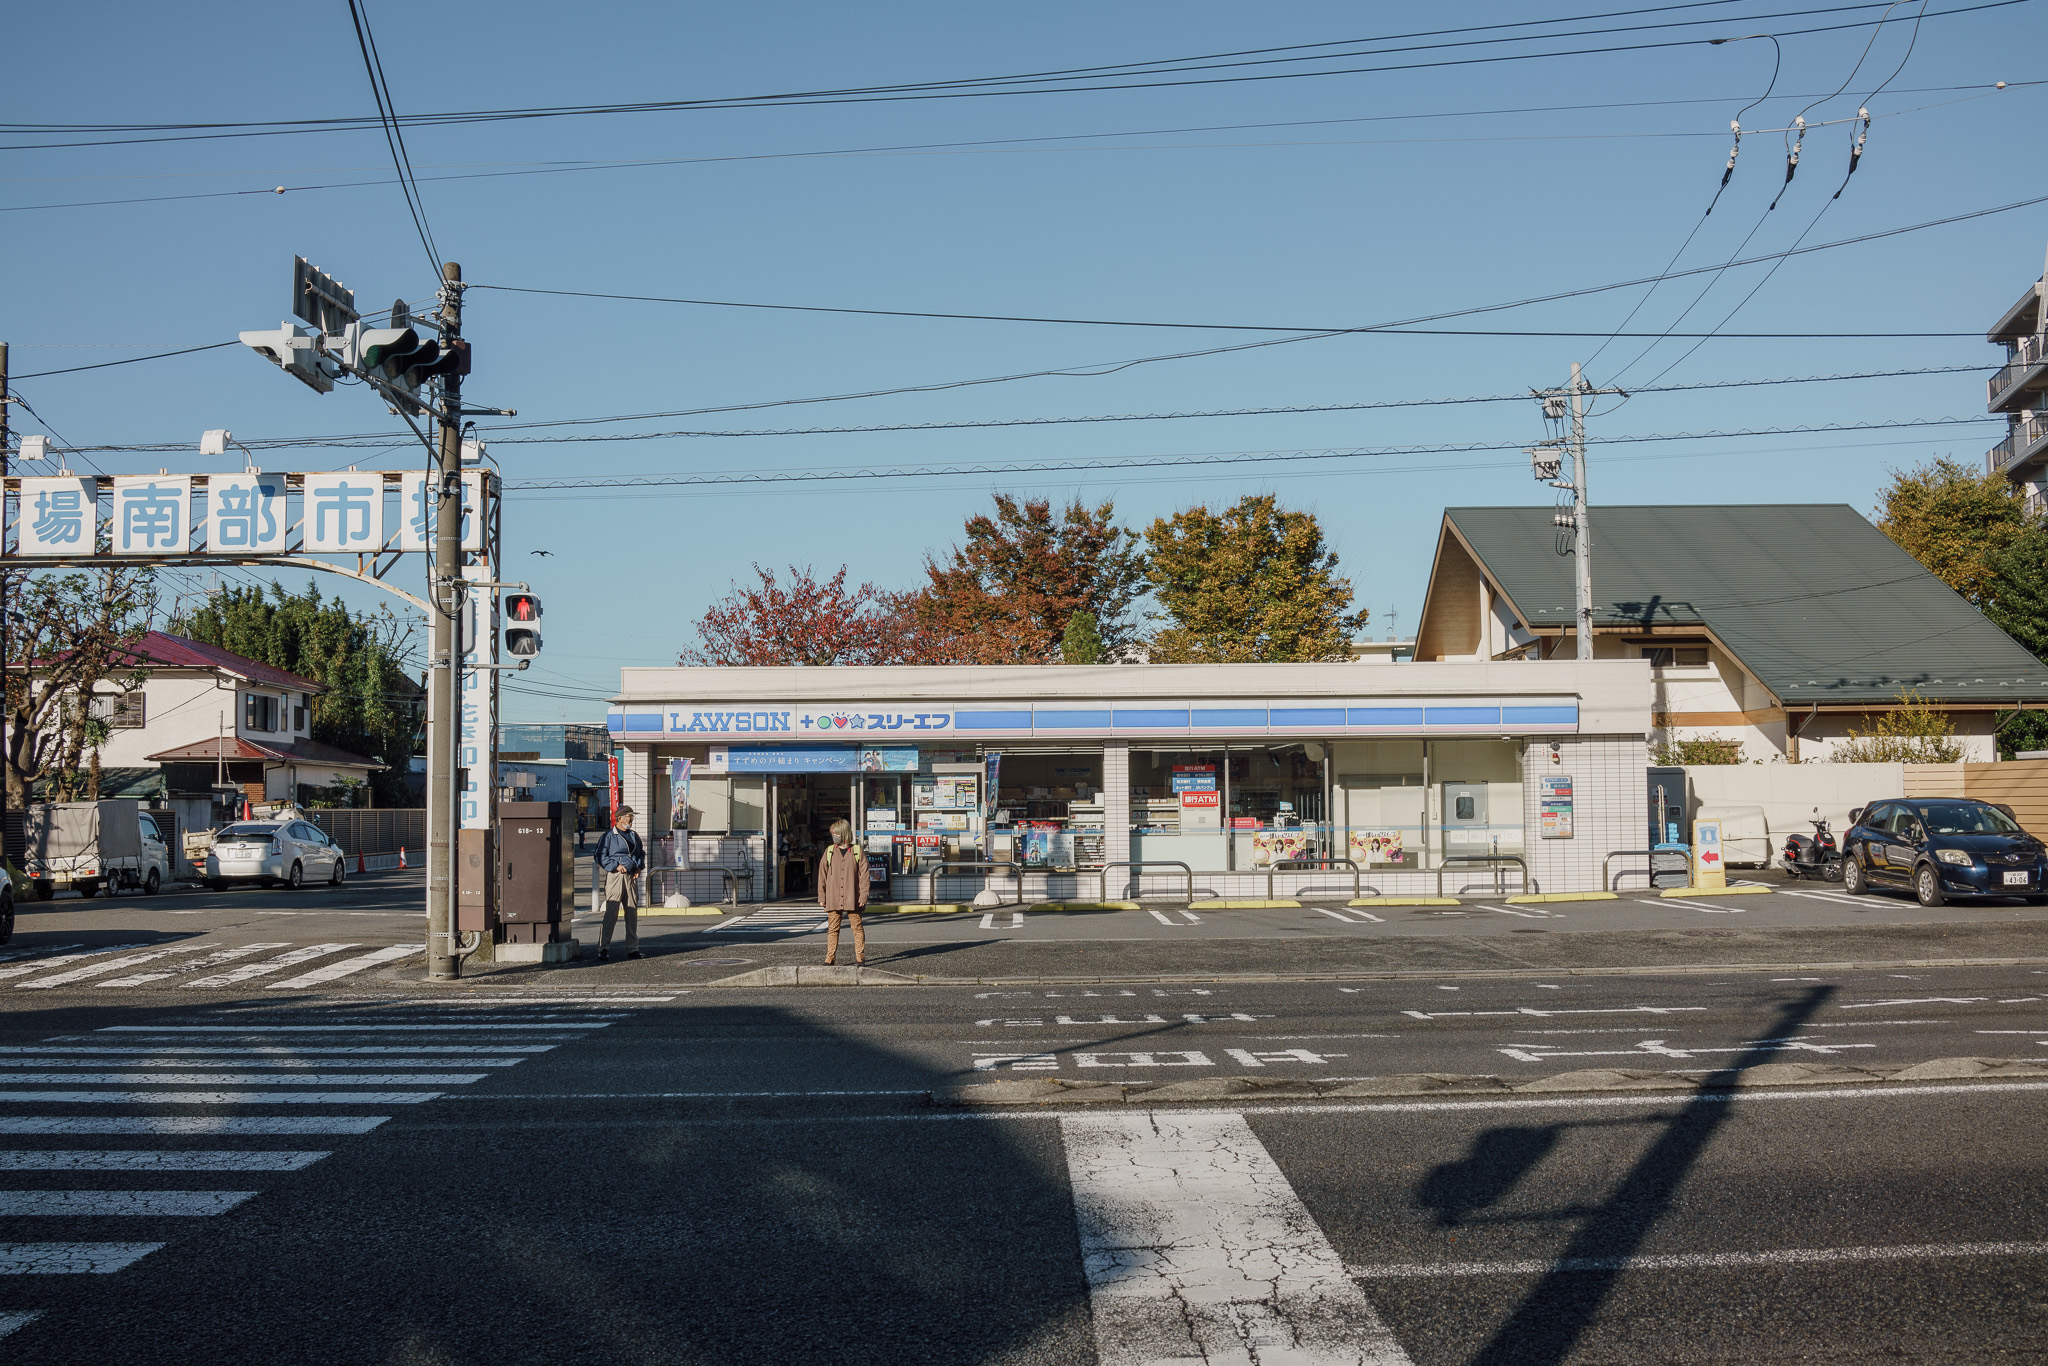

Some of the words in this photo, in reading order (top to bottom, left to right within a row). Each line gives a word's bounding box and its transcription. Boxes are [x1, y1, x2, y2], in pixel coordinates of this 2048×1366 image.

[669, 711, 791, 732] LAWSON
[867, 713, 951, 731] スリーエフ
[733, 756, 800, 765] すずめの戸締まり
[803, 756, 846, 765] キャンペーン
[1184, 795, 1217, 803] 銀行ATM
[2009, 876, 2027, 884] 43-06
